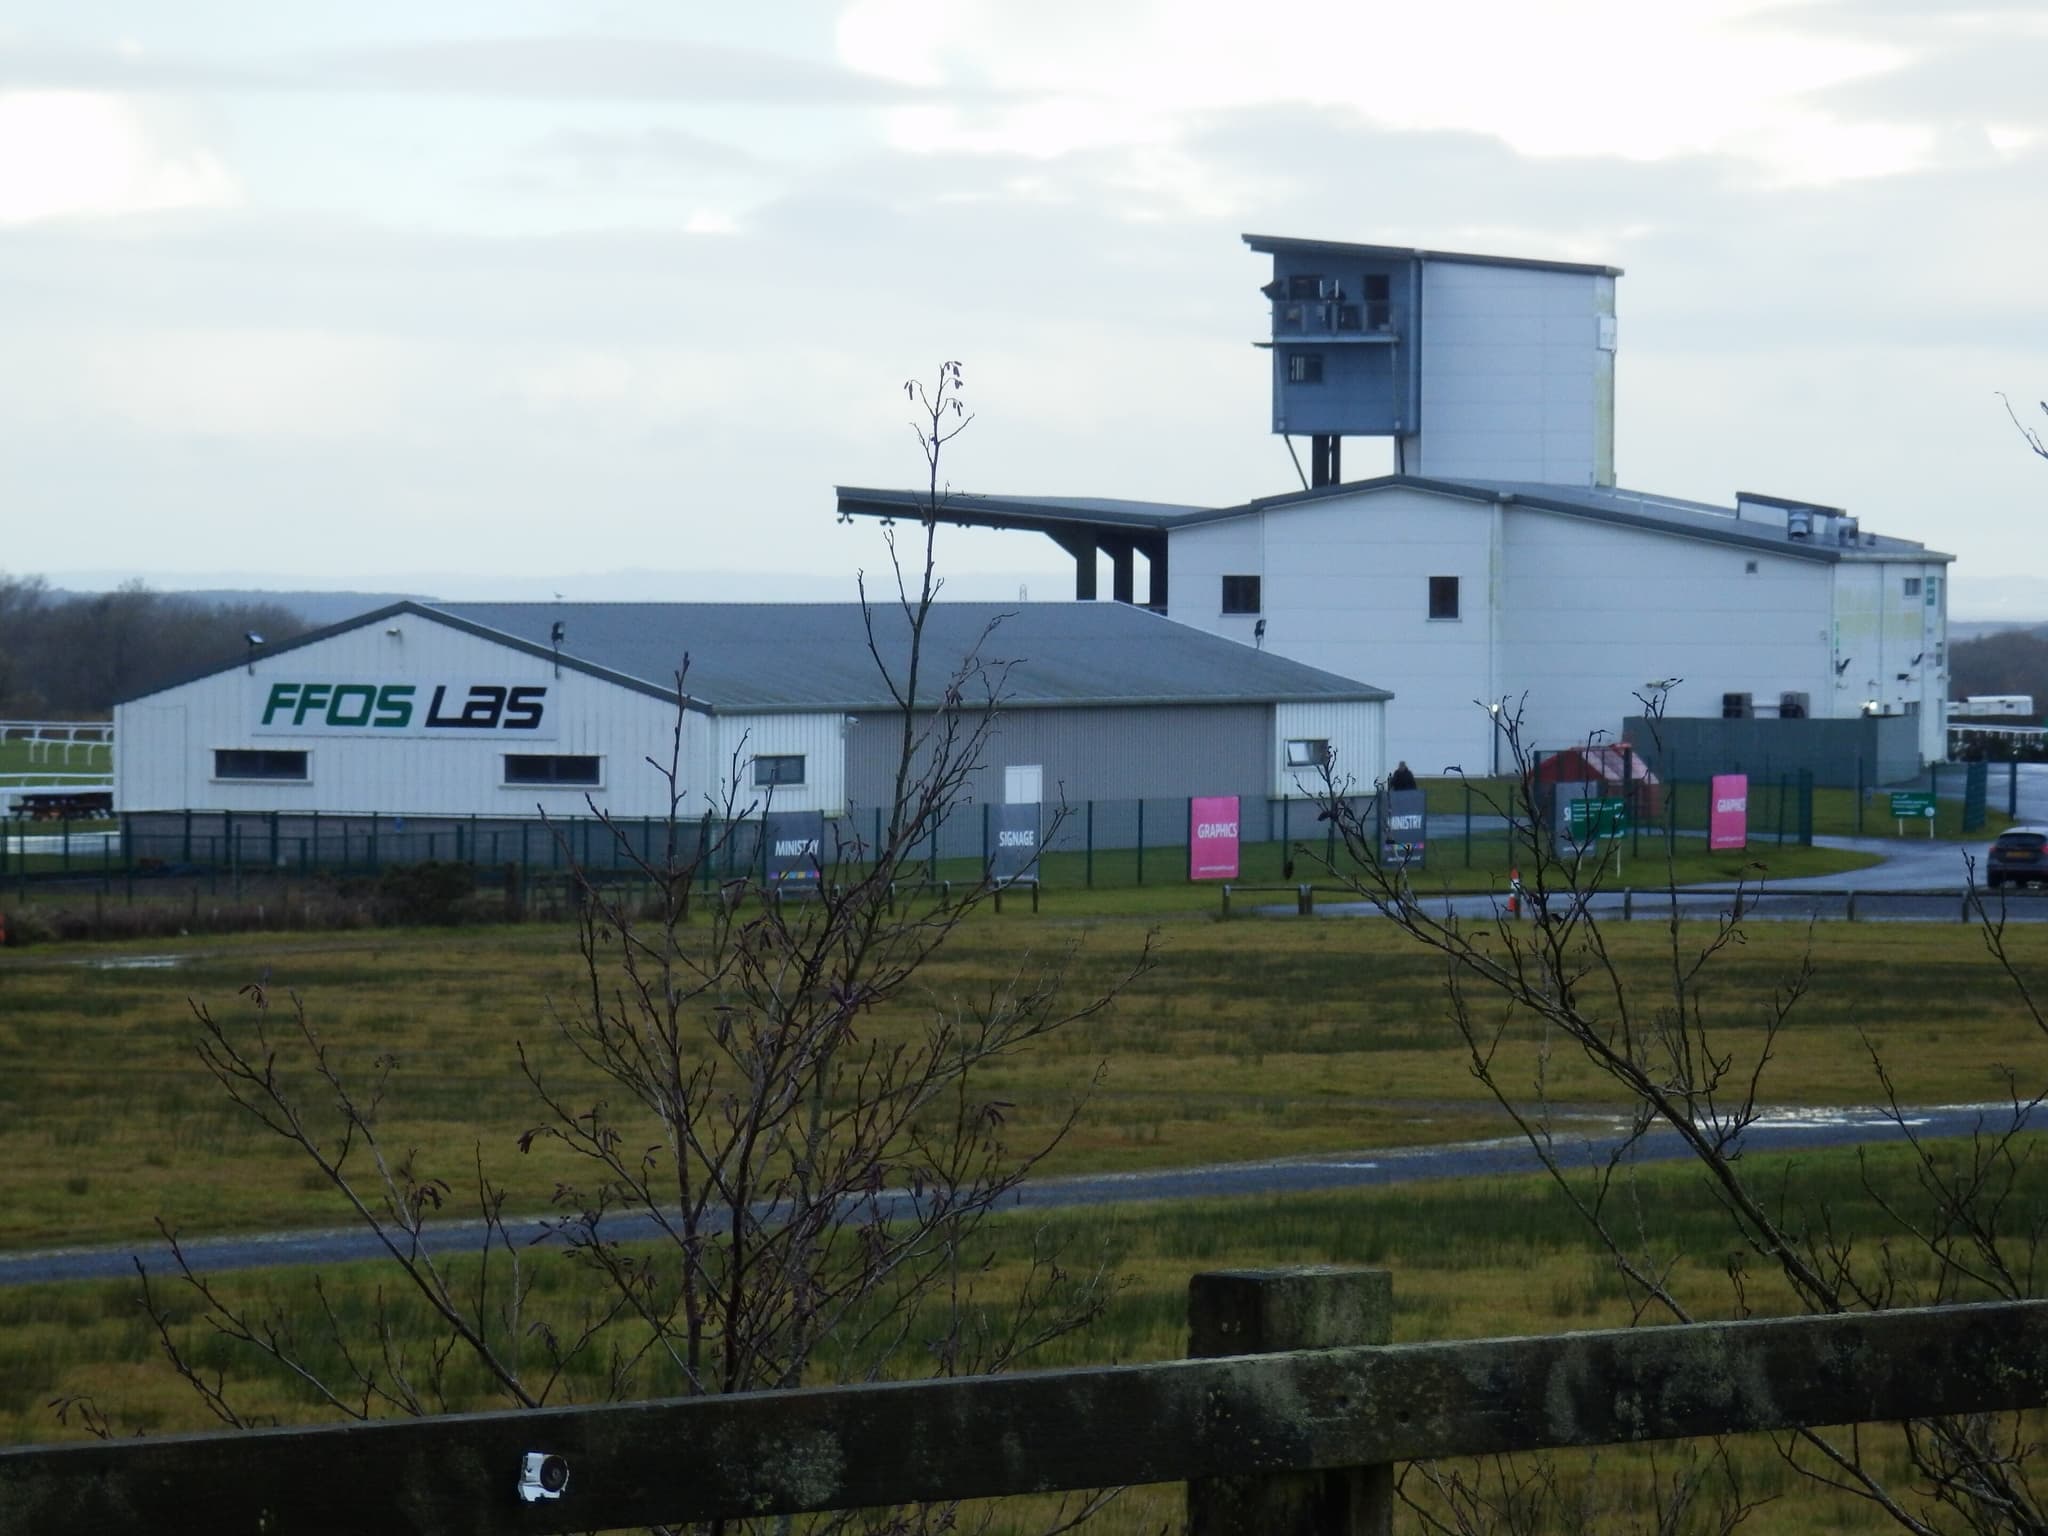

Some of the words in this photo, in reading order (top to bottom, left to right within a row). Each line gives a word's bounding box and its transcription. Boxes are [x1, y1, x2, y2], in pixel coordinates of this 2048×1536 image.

[261, 683, 416, 727] FFOS
[999, 830, 1034, 847] SIGNAGE
[1197, 823, 1238, 839] GRAPHICS
